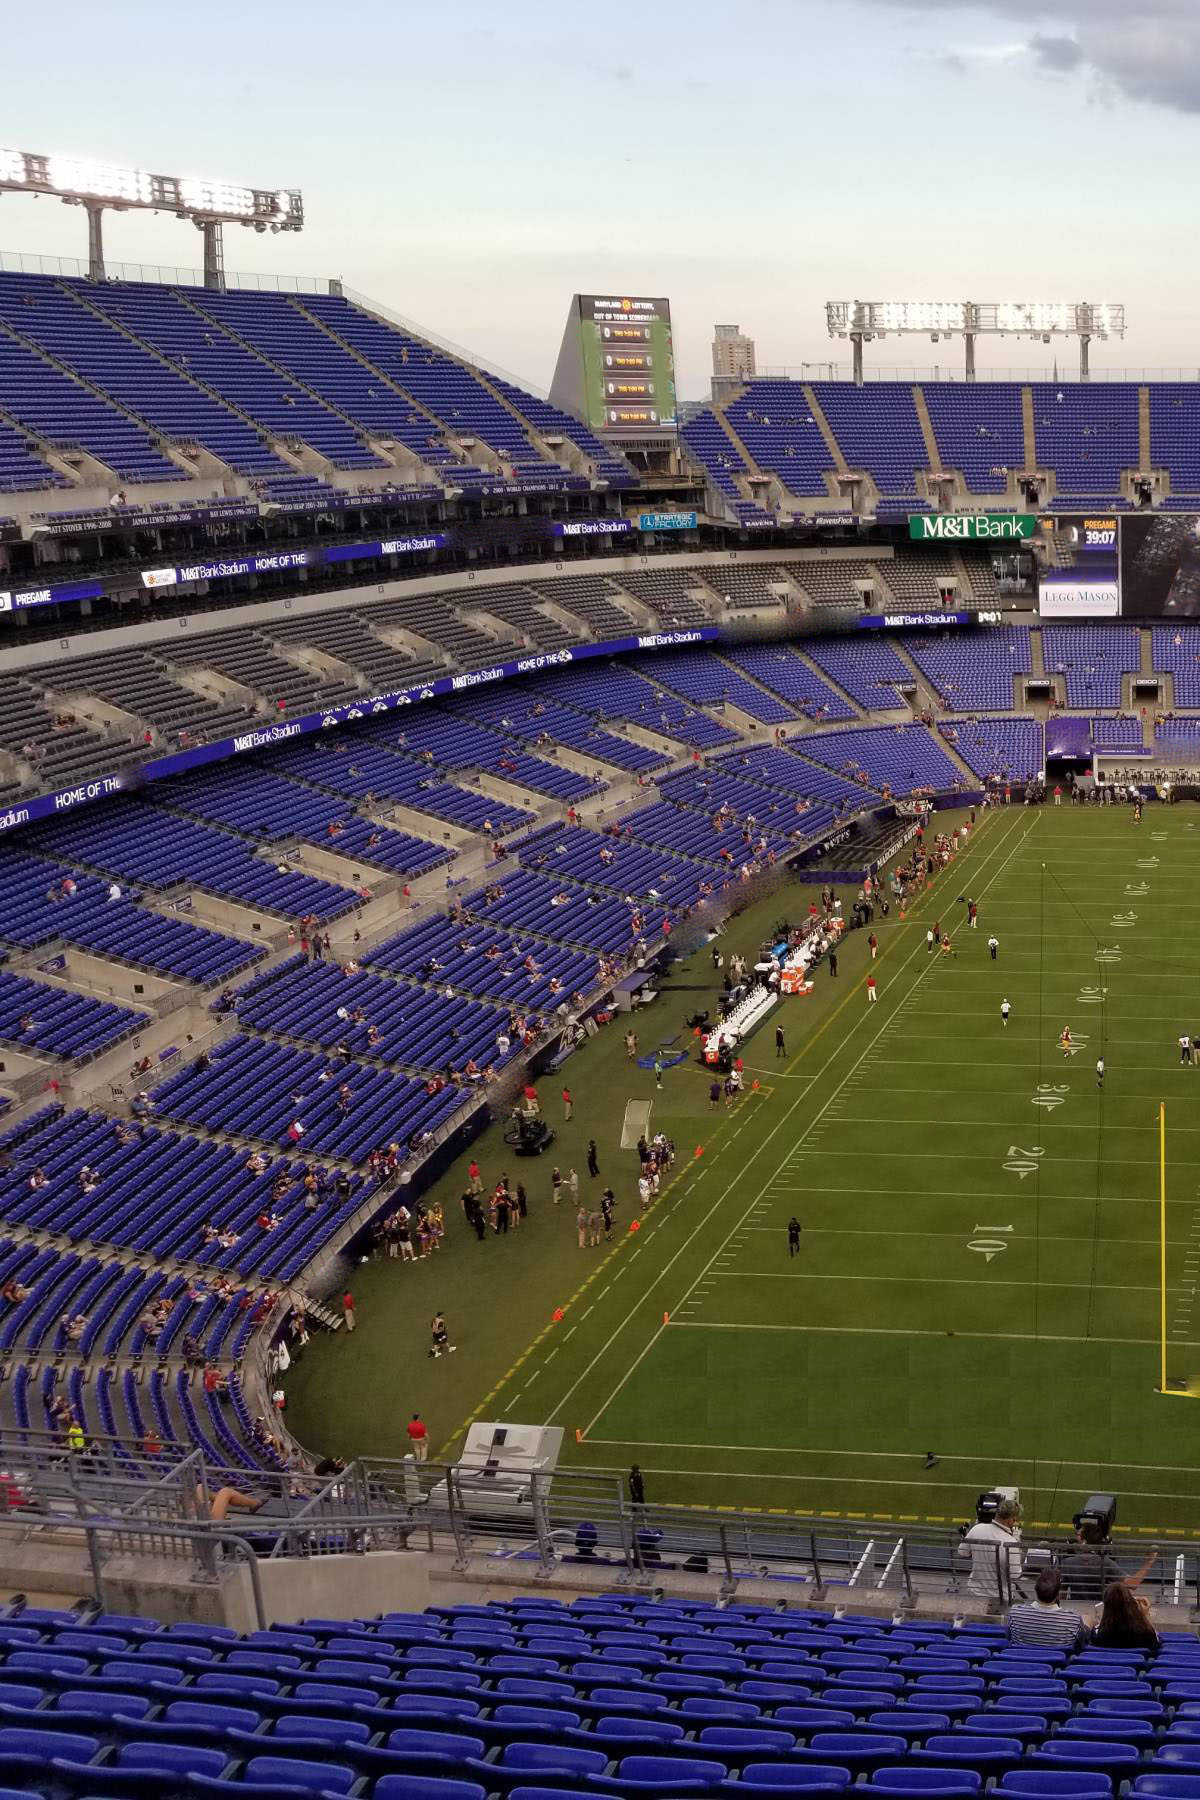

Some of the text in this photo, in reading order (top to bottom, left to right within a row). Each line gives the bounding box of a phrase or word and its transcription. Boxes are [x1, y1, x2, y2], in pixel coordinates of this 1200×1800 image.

[132, 517, 149, 526] JAMAL
[150, 516, 165, 525] LEWIS
[563, 520, 627, 535] M&T Bank Stadium
[656, 520, 692, 528] FACTORY
[922, 516, 974, 538] M&T
[976, 515, 1024, 537] Bank
[1084, 520, 1117, 529] PREGAME
[381, 538, 436, 553] M&T Bank Stadium
[1085, 531, 1115, 544] 39:07
[181, 567, 200, 581] M&T
[200, 564, 219, 579] Bank
[219, 561, 248, 577] Stadium
[255, 557, 278, 570] HOME
[279, 555, 290, 567] OF
[291, 553, 305, 566] THE
[16, 590, 51, 606] PREGAME
[1045, 591, 1117, 601] LEGG MASON
[884, 612, 957, 625] M&T Bank Stadium
[639, 631, 702, 647] M&T Bank Stadium
[452, 653, 558, 689] M&T Bank Stadium HOME OF THE
[234, 723, 301, 752] M&T Bank Stadium
[55, 787, 86, 808] HOME
[87, 781, 101, 798] OF
[0, 809, 30, 829] adium
[1031, 1083, 1071, 1105] 30
[1002, 1145, 1046, 1171] 20
[967, 1223, 1014, 1253] 10
